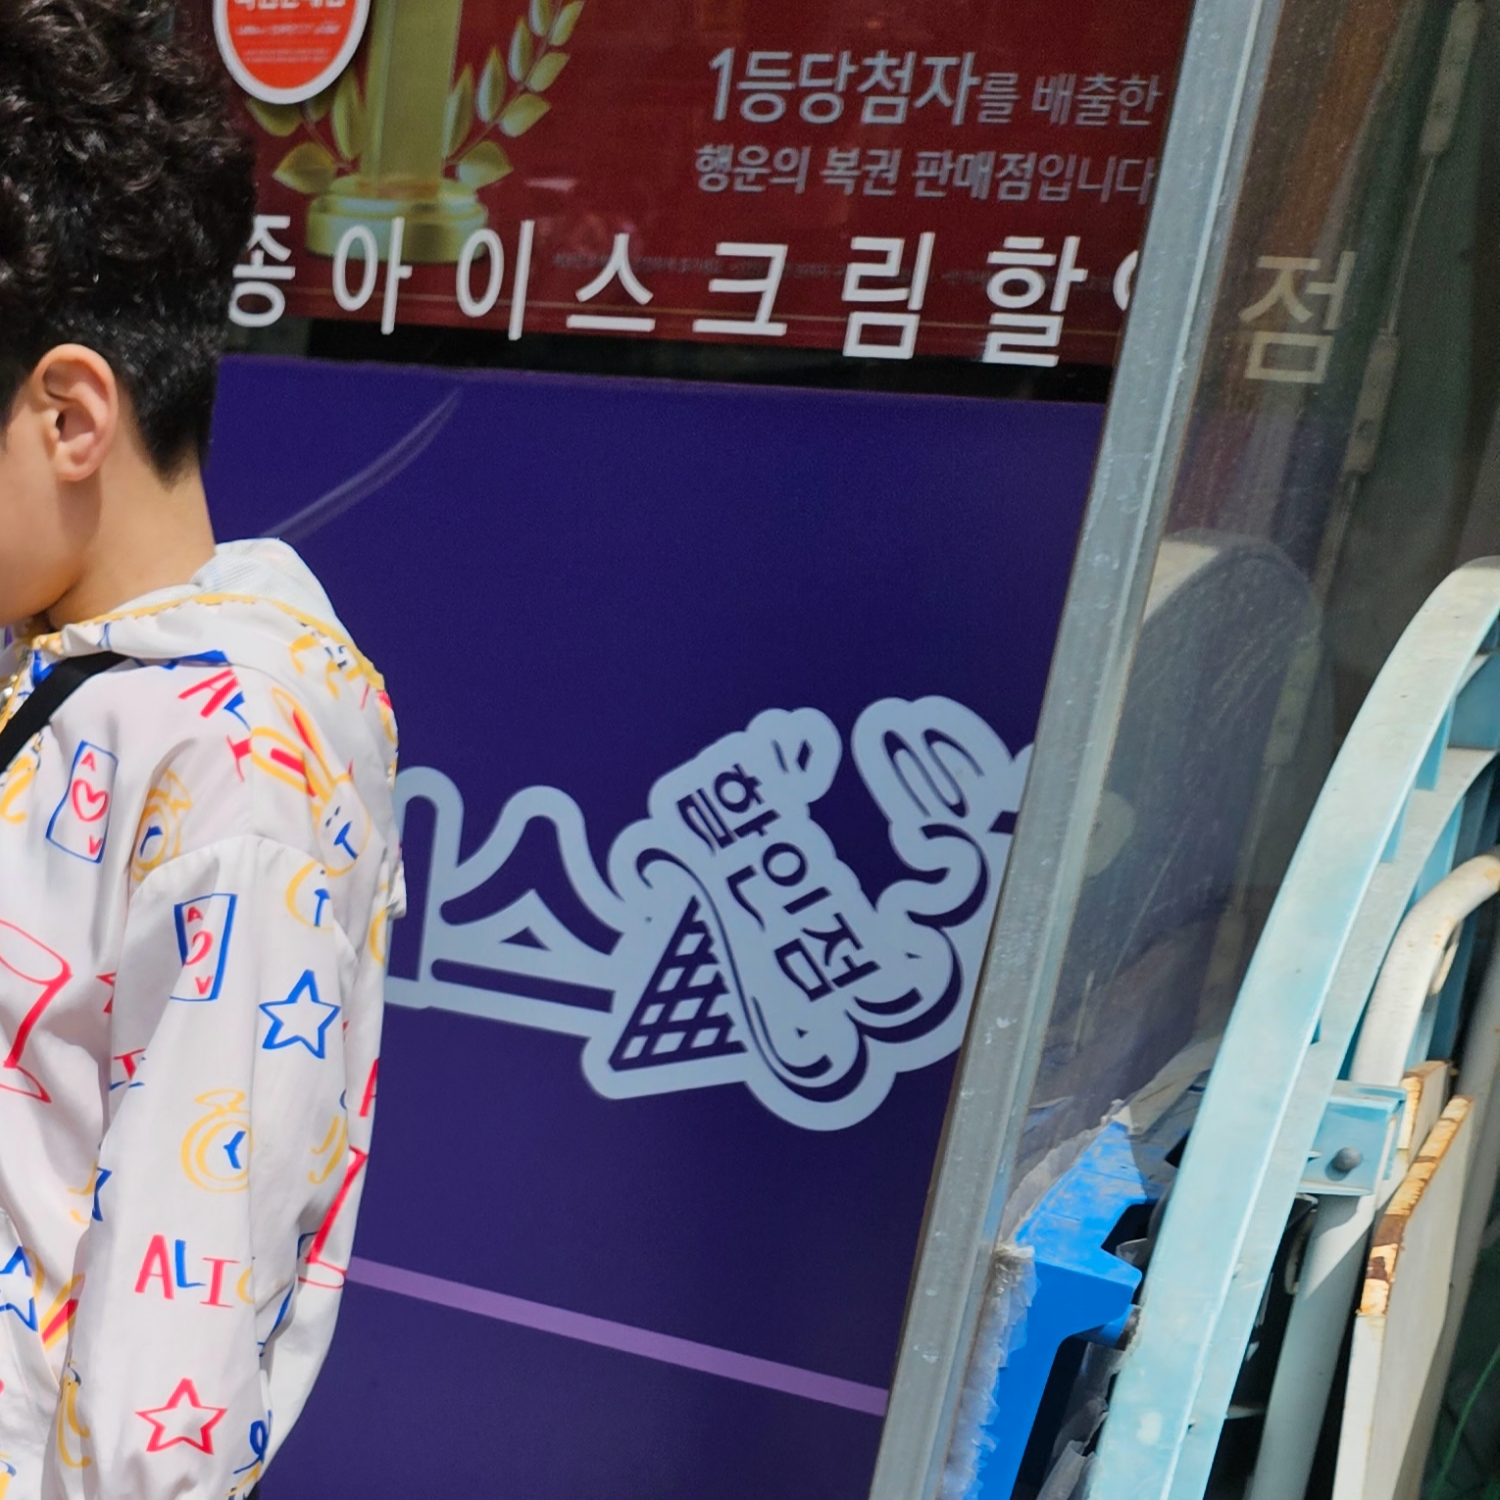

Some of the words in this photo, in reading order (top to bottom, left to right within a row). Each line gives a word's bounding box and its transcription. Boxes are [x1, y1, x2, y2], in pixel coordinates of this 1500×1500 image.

[708, 47, 1022, 126] 1등당첨자를
[1031, 70, 1164, 128] 배출한
[696, 143, 809, 193] 행운의
[821, 147, 902, 196] 복권
[912, 150, 1156, 205] 판매점입니다
[676, 763, 882, 1002] 할인점
